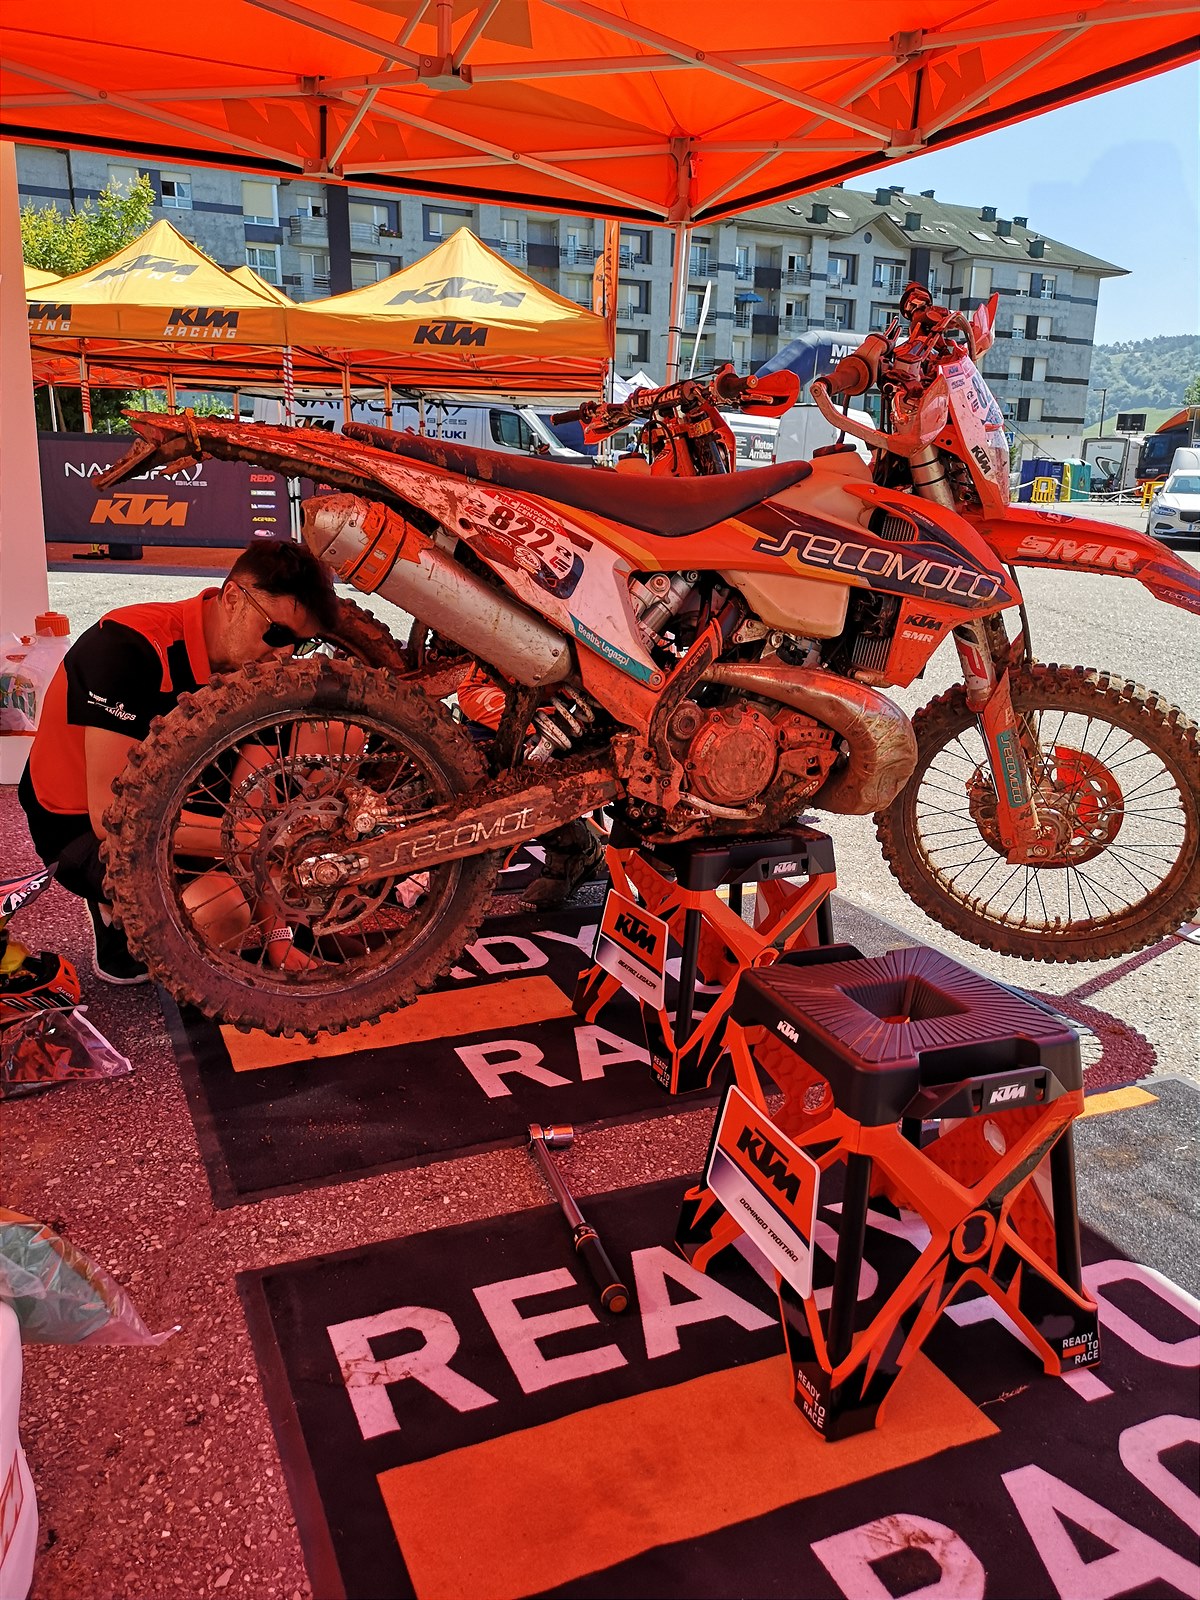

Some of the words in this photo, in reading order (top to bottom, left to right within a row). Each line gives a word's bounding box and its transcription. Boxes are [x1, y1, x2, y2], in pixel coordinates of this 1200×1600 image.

[384, 277, 527, 308] KTM
[167, 305, 240, 328] KTM
[413, 320, 489, 346] KTM
[970, 445, 992, 475] KTM
[89, 493, 189, 527] KTM
[487, 505, 555, 557] 822
[1017, 535, 1141, 571] SMR
[903, 613, 943, 631] KTM
[901, 630, 935, 643] SMR
[773, 861, 797, 874] KTM
[613, 911, 657, 956] KTM
[777, 1020, 800, 1044] KTM
[653, 1055, 669, 1071] READY
[656, 1073, 670, 1088] RACE
[663, 1071, 670, 1081] TO
[989, 1083, 1027, 1104] KTM
[736, 1125, 802, 1206] KTM
[739, 1197, 768, 1231] DOMINGO
[767, 1228, 799, 1263] TROITIÑO
[1062, 1331, 1094, 1349] READY
[1087, 1339, 1099, 1351] TO
[1074, 1349, 1099, 1365] RACE
[797, 1369, 821, 1401] READY
[803, 1400, 825, 1429] RACE
[814, 1400, 826, 1418] TO
